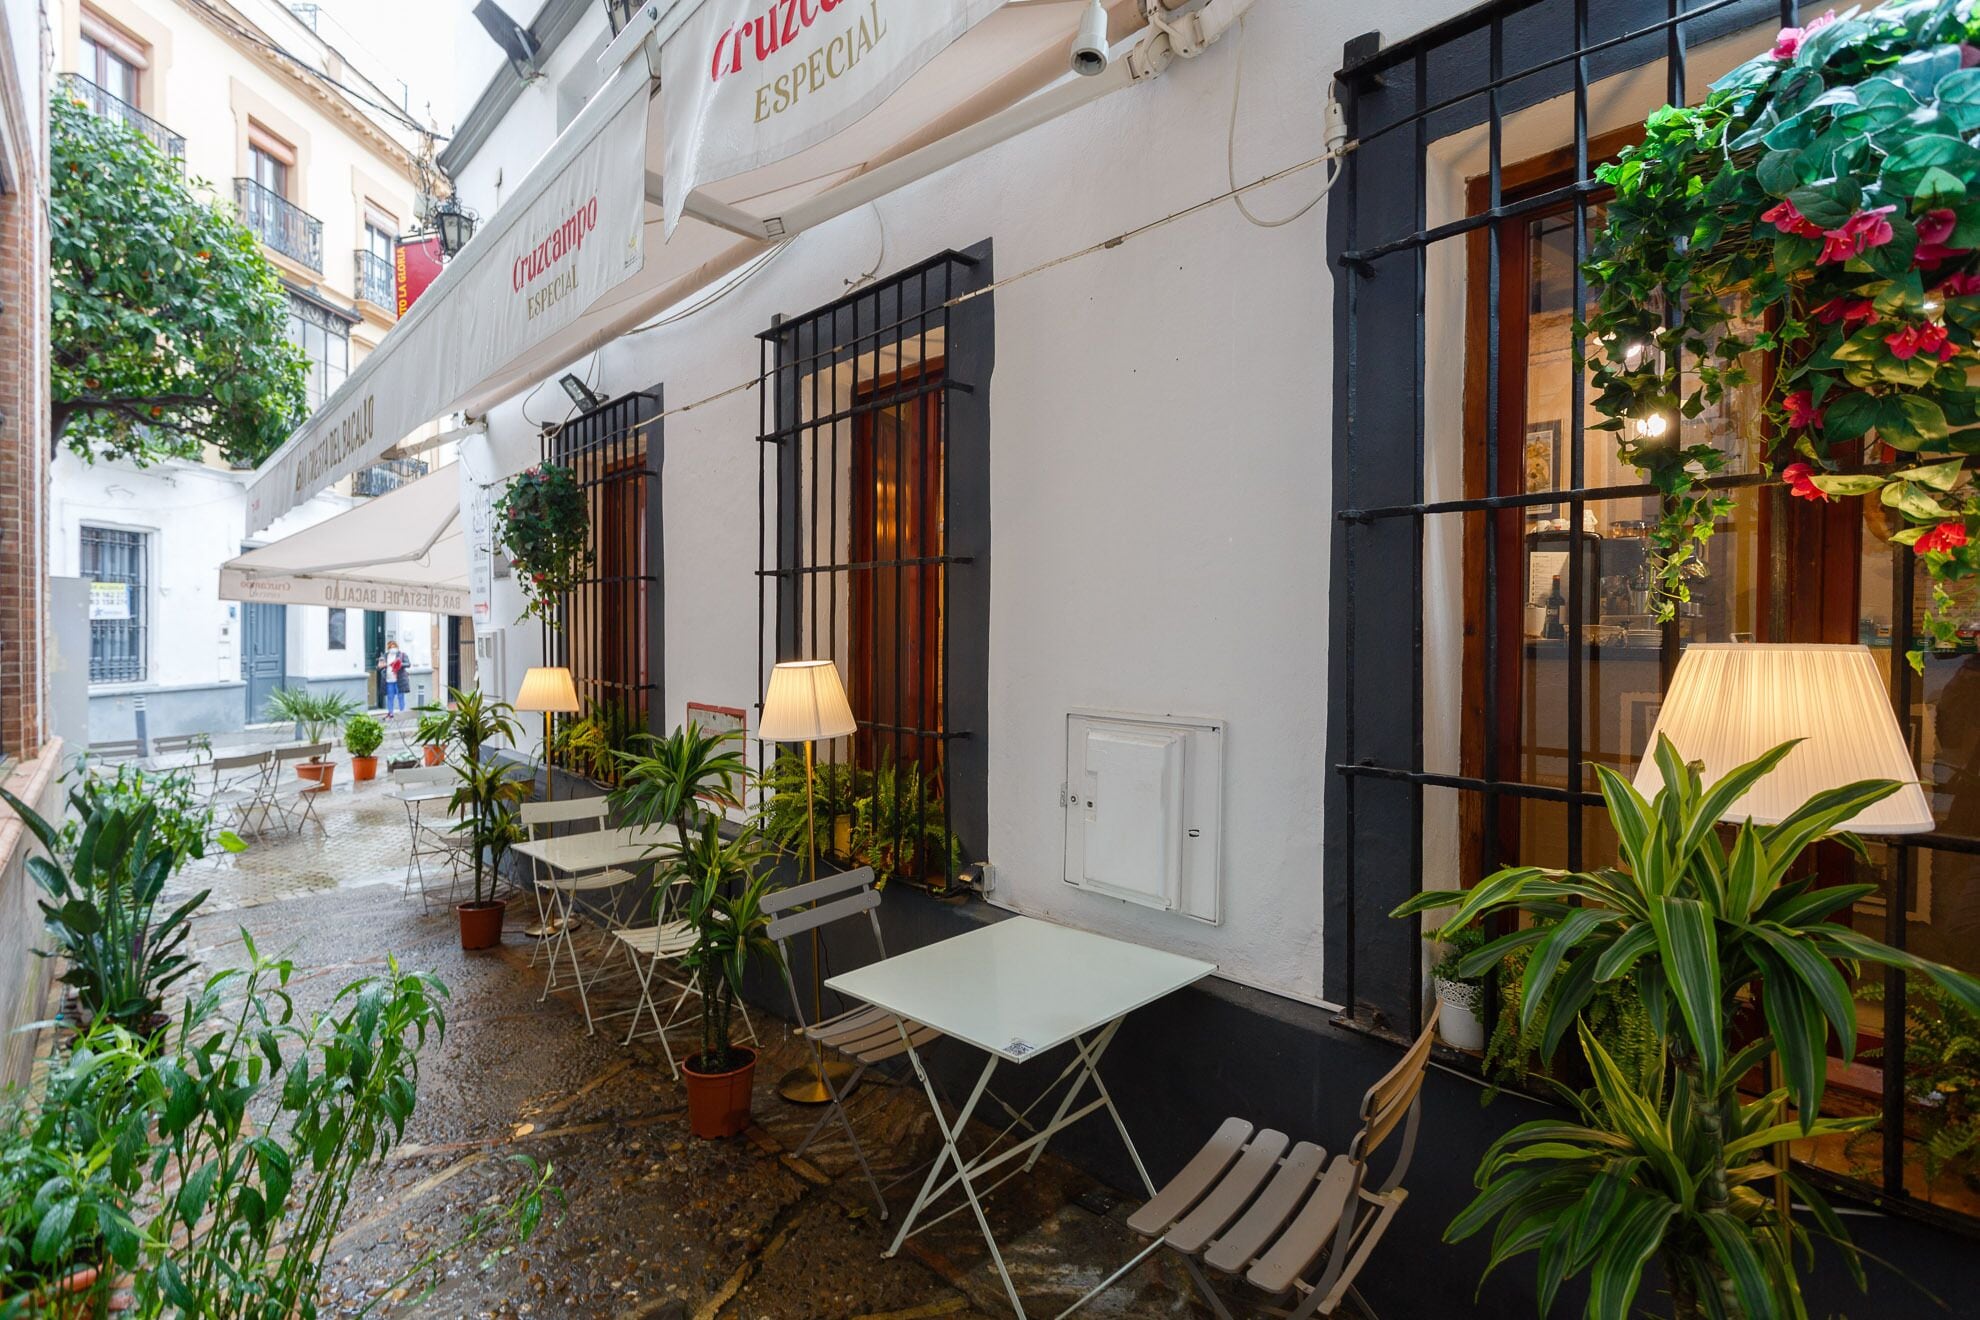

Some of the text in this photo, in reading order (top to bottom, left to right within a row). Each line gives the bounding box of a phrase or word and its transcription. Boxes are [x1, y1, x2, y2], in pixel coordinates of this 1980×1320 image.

[711, 0, 844, 83] Cruzc
[753, 1, 888, 124] ESPECIAL
[397, 246, 407, 283] GLORIA
[513, 195, 598, 294] Cruzcampo
[398, 284, 408, 298] LA
[527, 264, 579, 321] ESPECIAL
